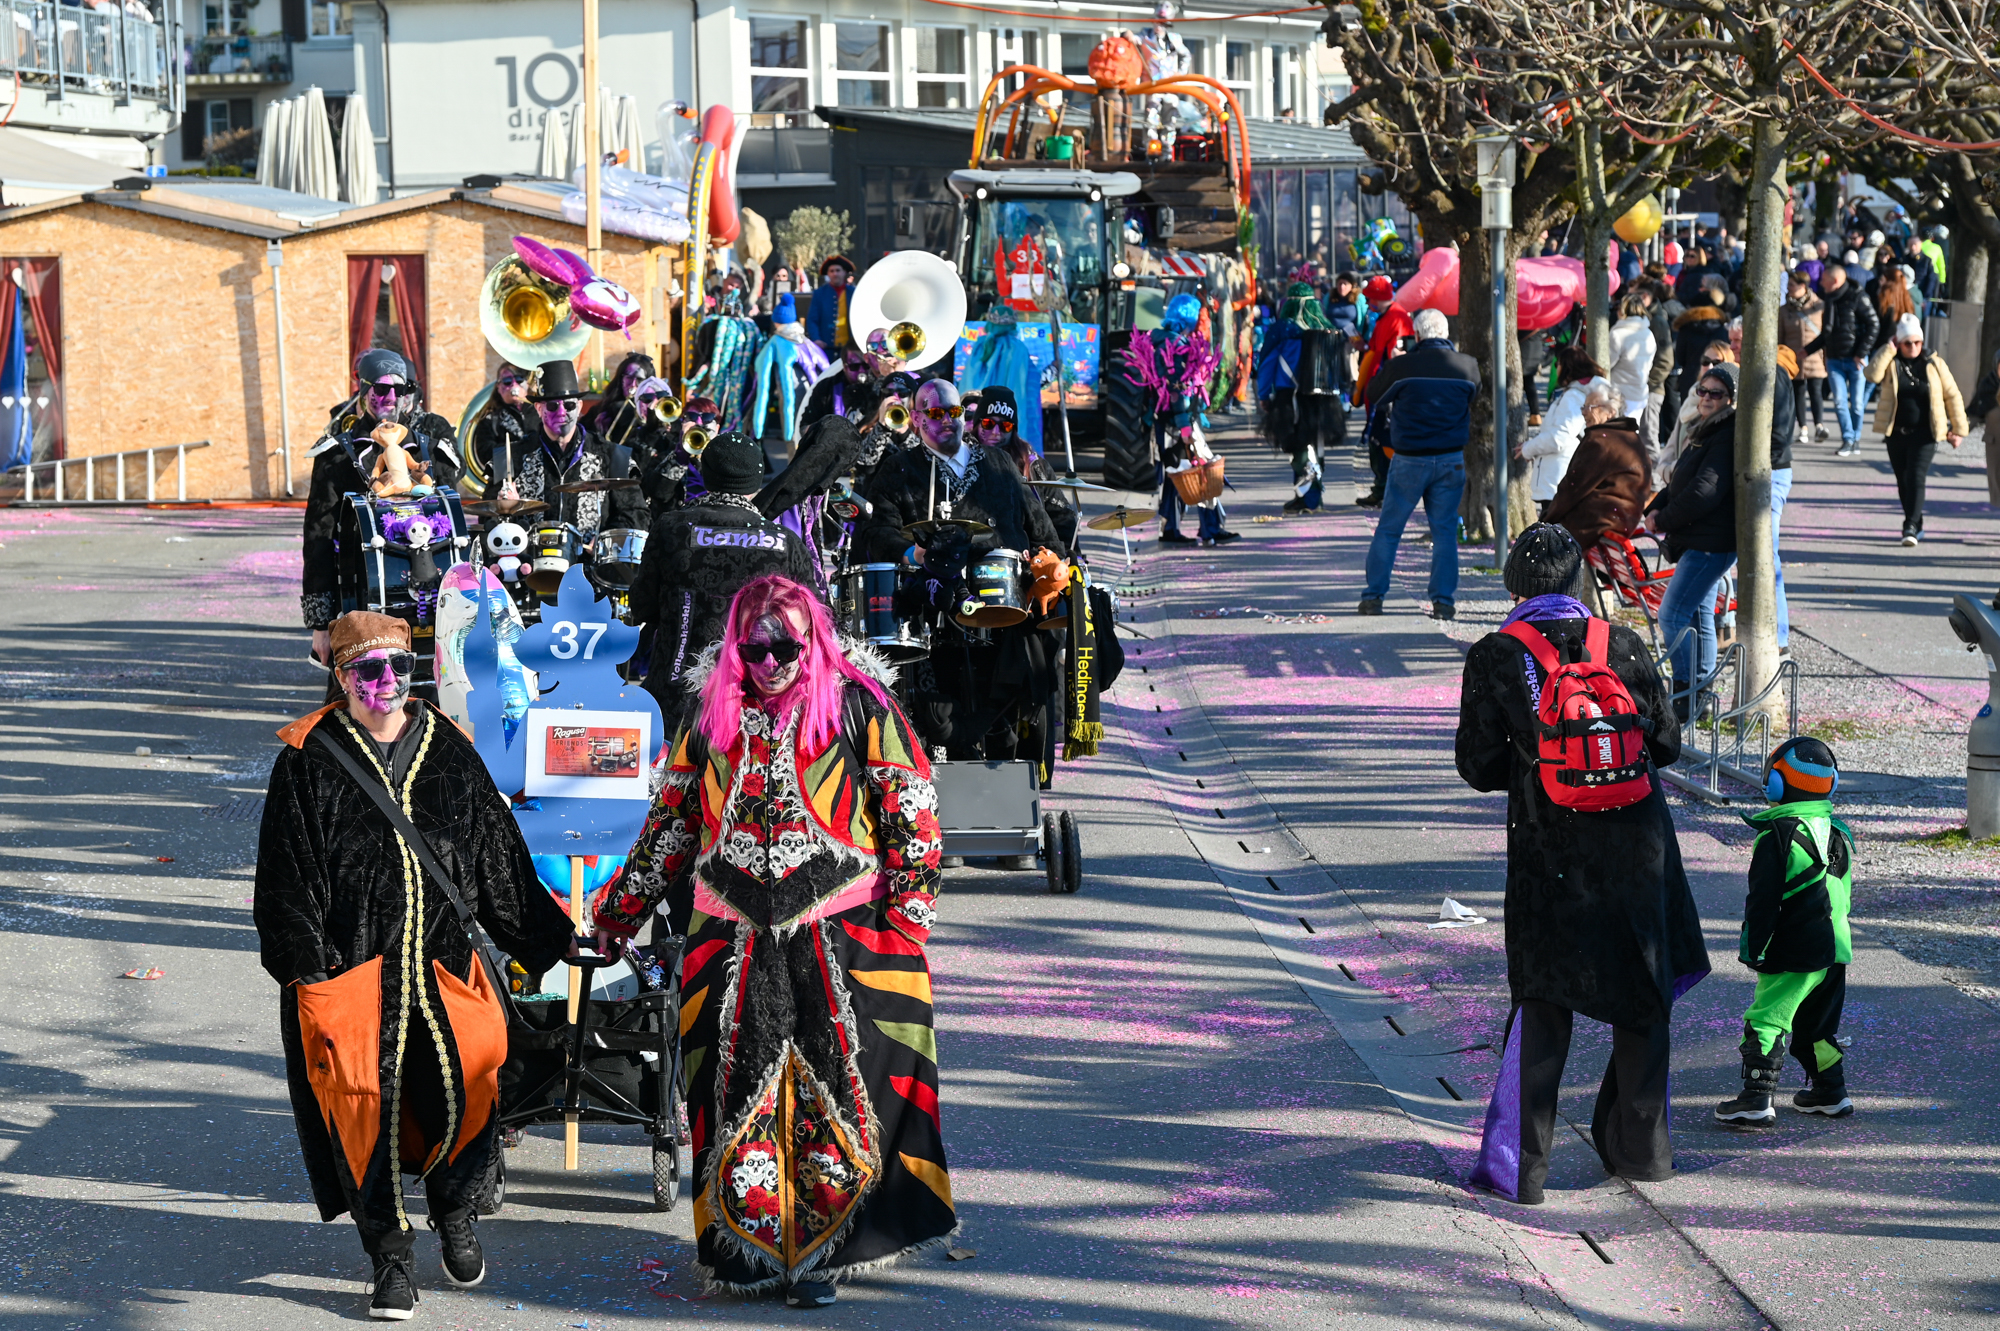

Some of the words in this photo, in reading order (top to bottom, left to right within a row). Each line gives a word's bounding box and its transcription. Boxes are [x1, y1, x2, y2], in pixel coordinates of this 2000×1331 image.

[694, 527, 785, 550] Tambi
[550, 620, 608, 660] 37
[553, 727, 586, 738] Ragusa
[1597, 737, 1613, 764] SPIRIT
